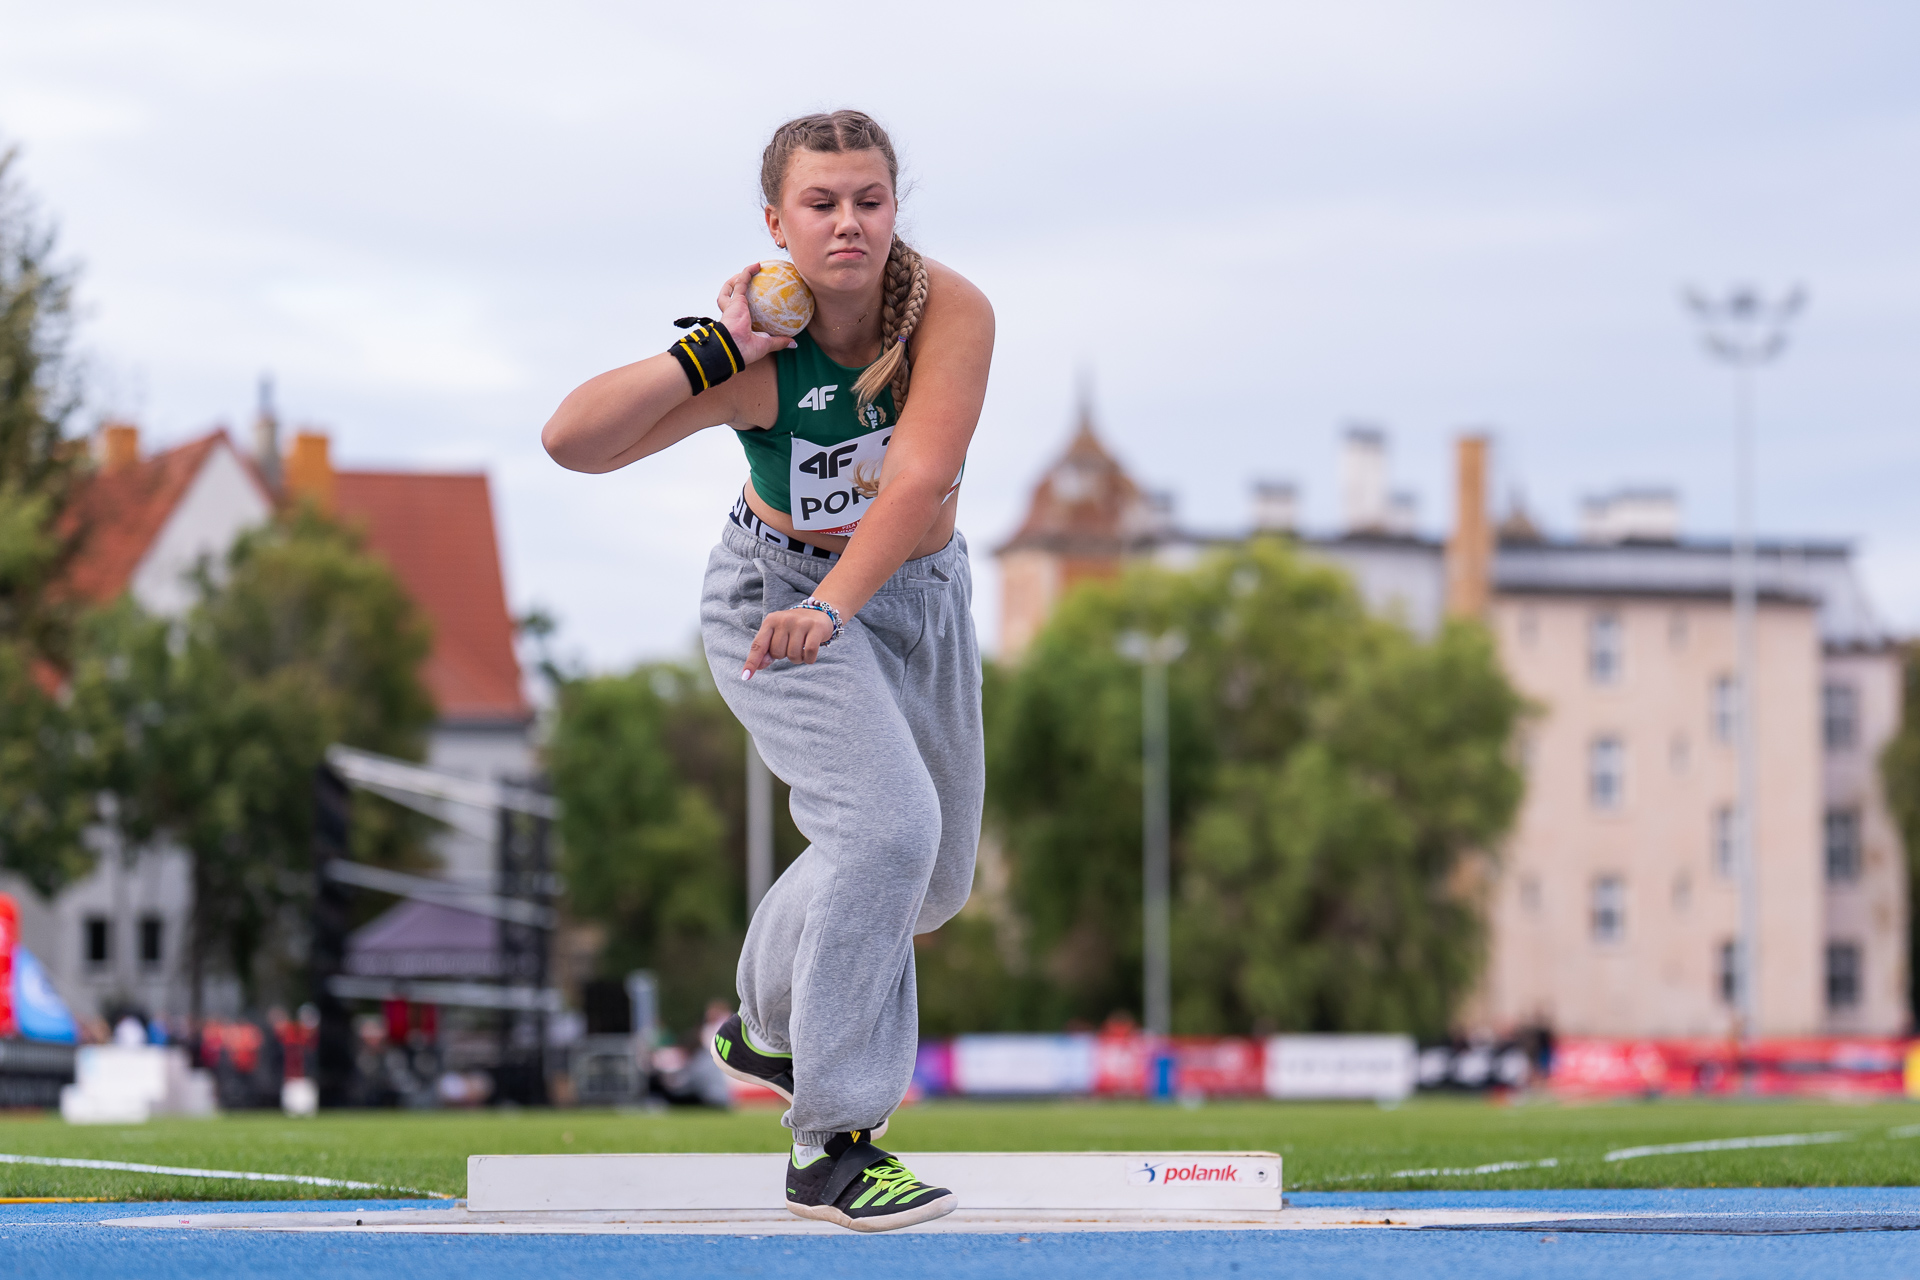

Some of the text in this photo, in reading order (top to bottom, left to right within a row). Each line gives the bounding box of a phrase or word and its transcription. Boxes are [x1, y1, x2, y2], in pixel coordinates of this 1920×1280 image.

[798, 384, 838, 411] 4F
[865, 402, 878, 429] AWF
[799, 443, 858, 480] 4F
[1163, 1164, 1238, 1185] polanik
